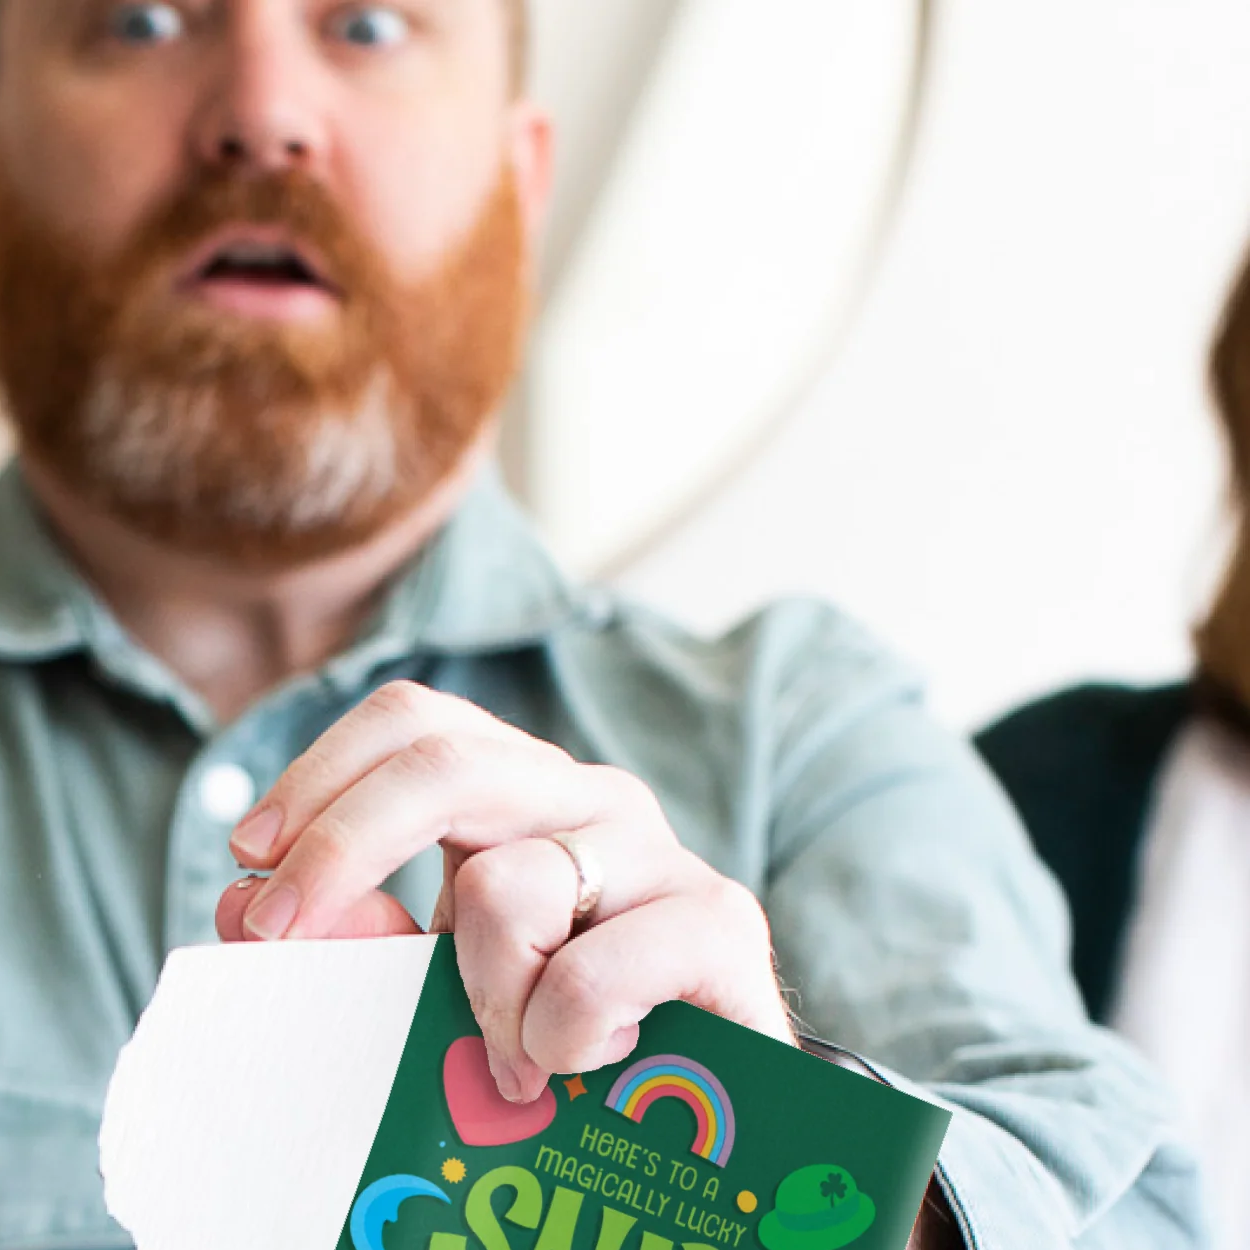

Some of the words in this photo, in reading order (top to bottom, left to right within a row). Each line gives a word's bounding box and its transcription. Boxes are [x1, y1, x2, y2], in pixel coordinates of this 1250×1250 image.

[669, 1159, 698, 1192] TO
[702, 1176, 720, 1201] A
[674, 1202, 748, 1248] LUCKY
